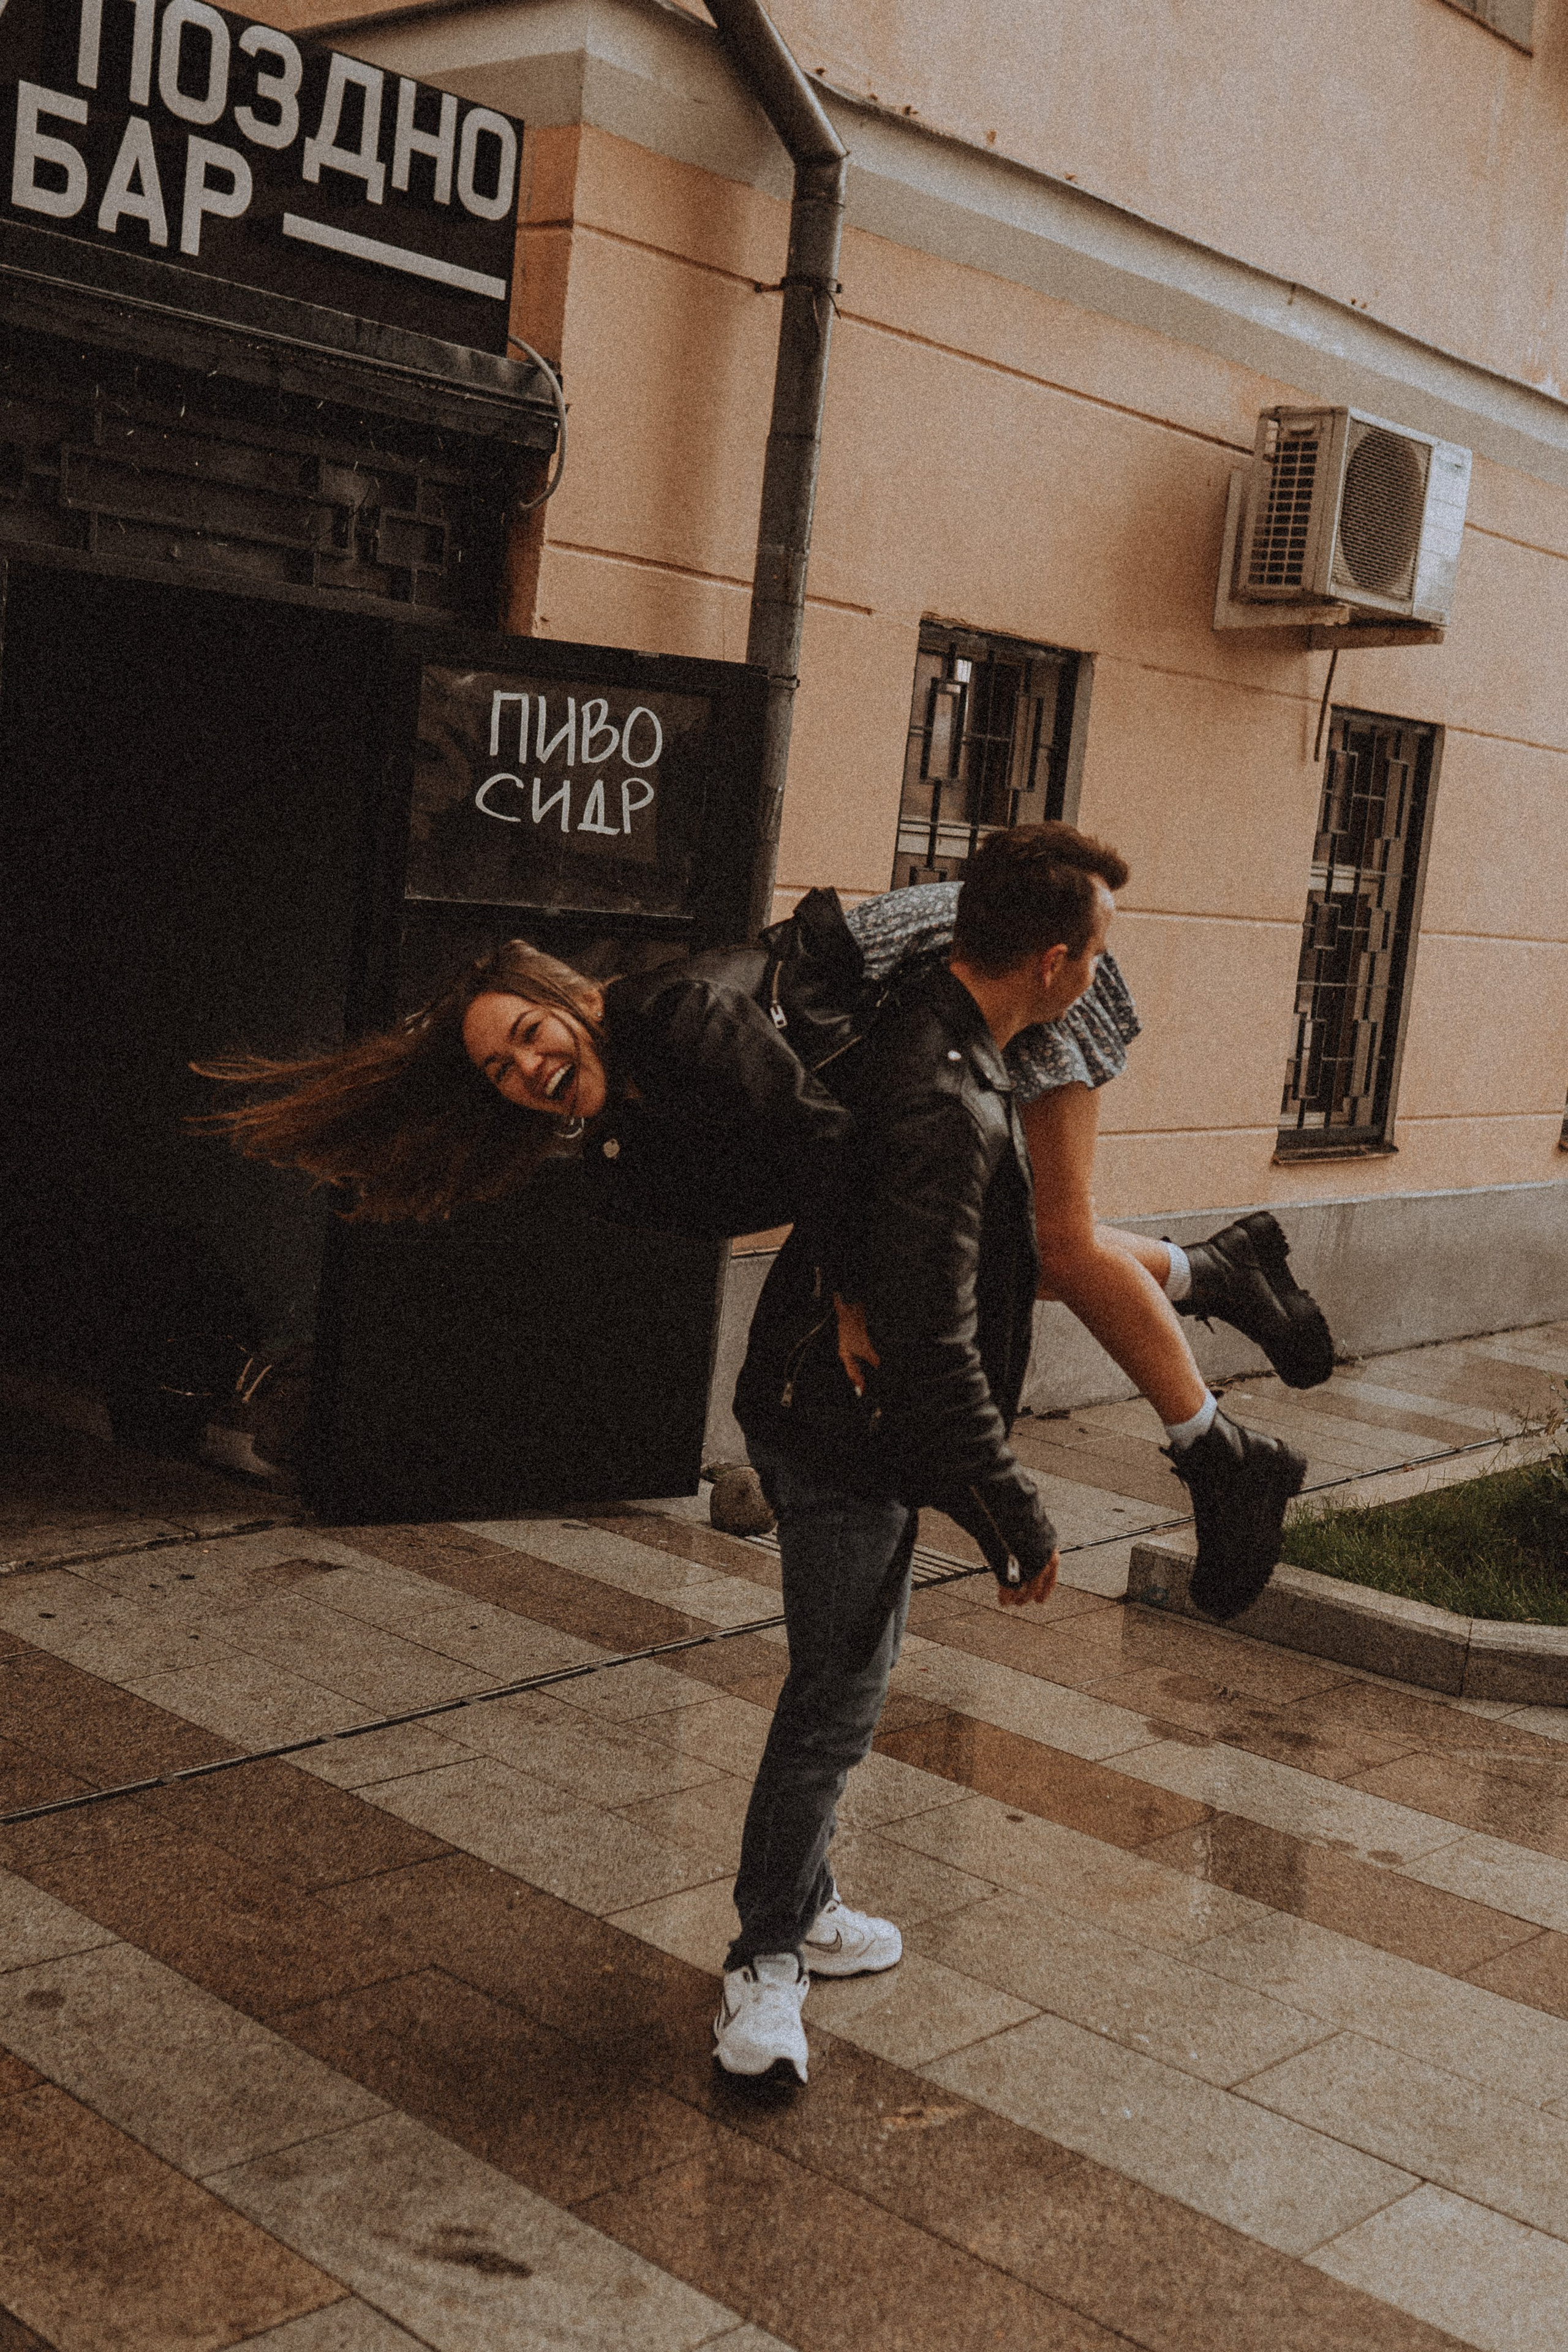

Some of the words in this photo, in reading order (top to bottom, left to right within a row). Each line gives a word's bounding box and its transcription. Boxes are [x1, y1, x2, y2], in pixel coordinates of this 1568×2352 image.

[11, 80, 252, 256] БАР
[77, 0, 518, 221] ПОЗДНО
[490, 690, 663, 768] ПИВО
[475, 772, 655, 835] СИДР
